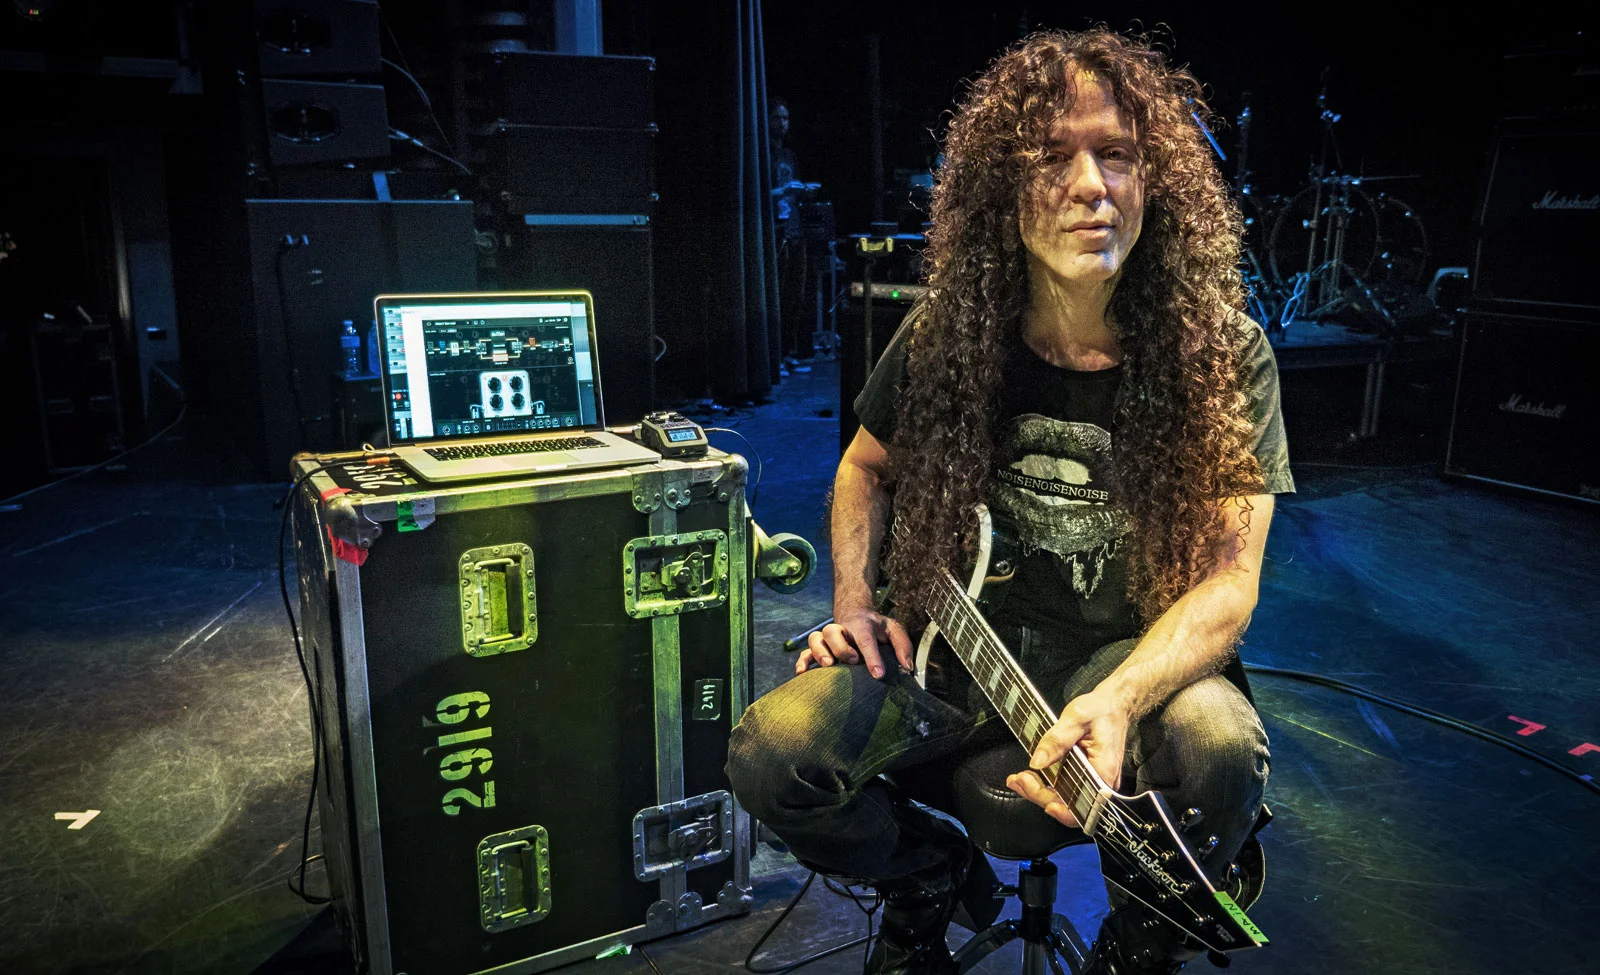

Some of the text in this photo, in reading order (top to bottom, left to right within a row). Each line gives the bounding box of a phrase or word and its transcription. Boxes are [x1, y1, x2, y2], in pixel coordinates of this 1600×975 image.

[1499, 394, 1566, 418] Marshall
[997, 469, 1109, 500] NOISENOISENOISE
[701, 684, 716, 710] 2919
[436, 691, 496, 816] 2919
[1128, 839, 1189, 895] Jackson
